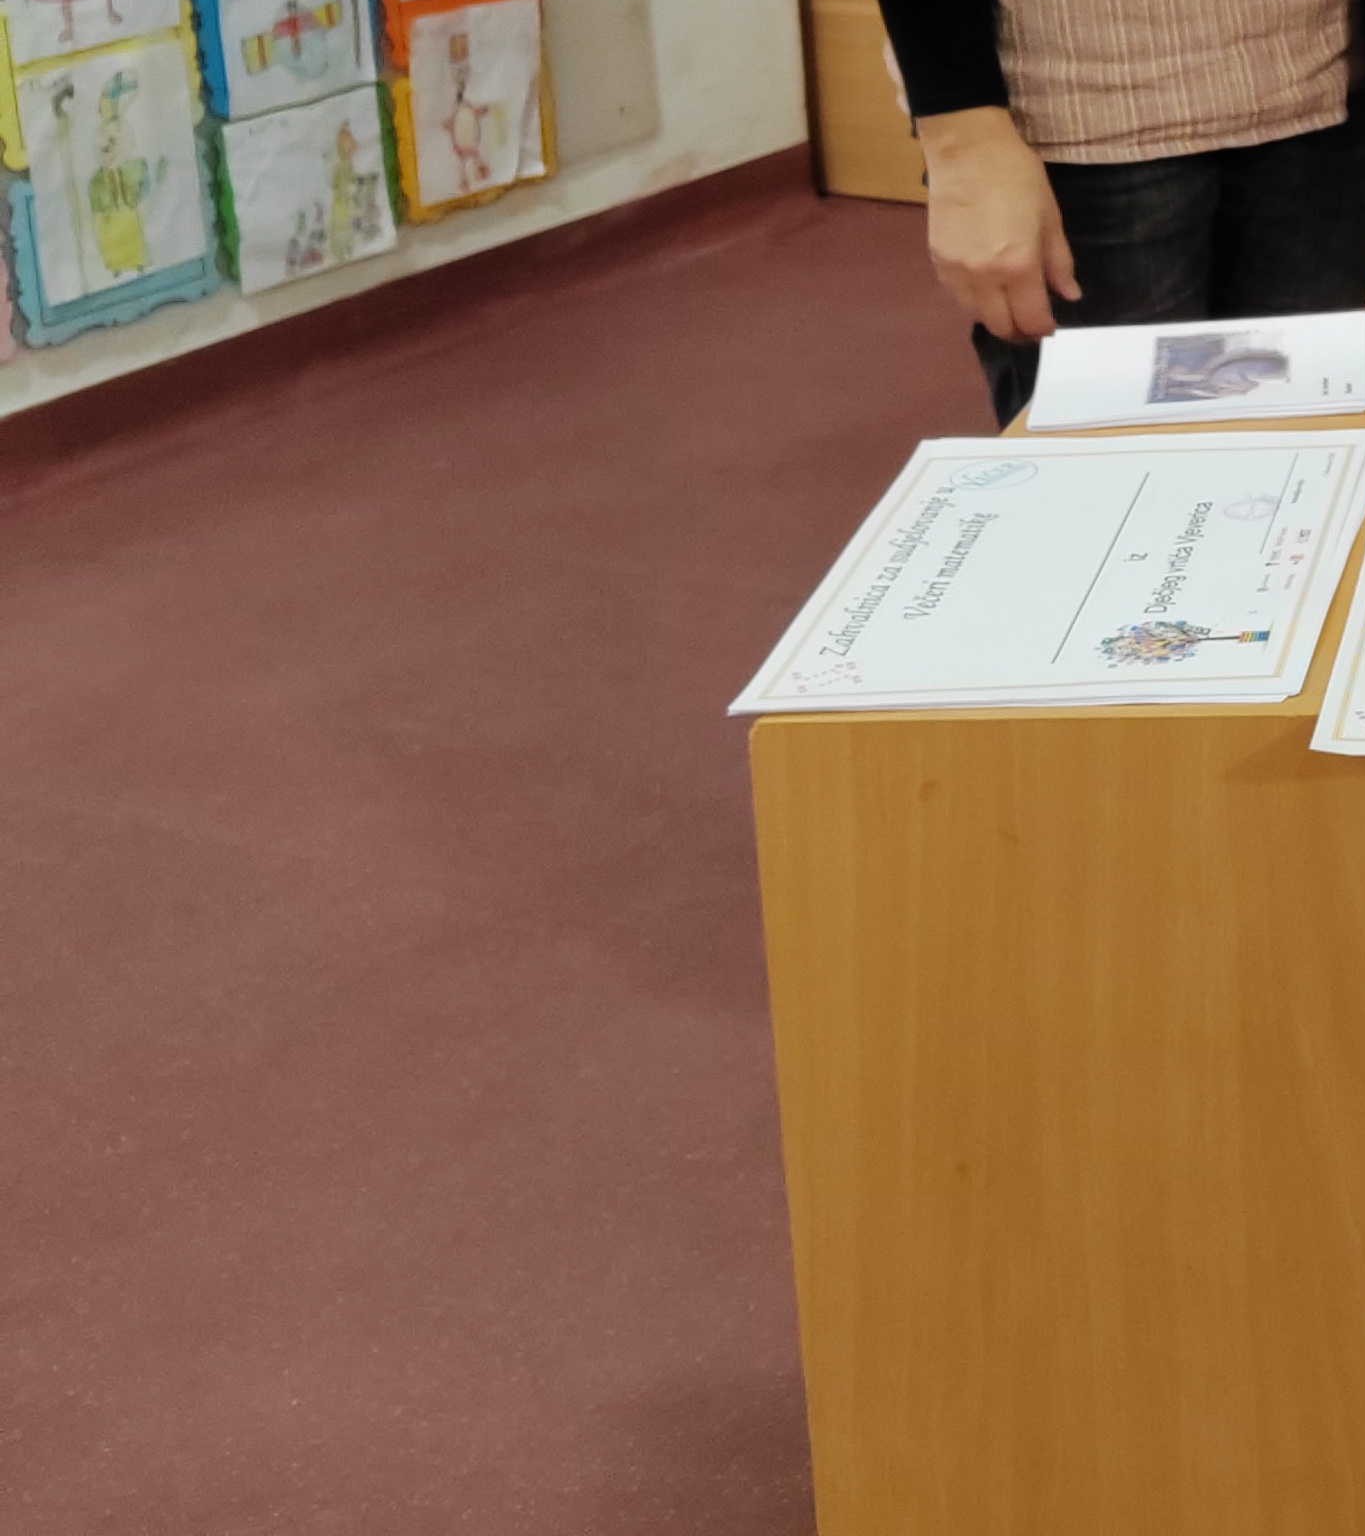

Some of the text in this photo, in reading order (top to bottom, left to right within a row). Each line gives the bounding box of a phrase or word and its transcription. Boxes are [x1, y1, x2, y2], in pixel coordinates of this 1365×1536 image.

[888, 495, 956, 565] sudjelovanje
[903, 511, 1000, 620] Večeri matematike
[1122, 551, 1149, 563] iz
[1144, 500, 1214, 614] Dječjeg vrtića Vjeverica
[877, 565, 903, 583] za
[818, 583, 890, 657] Zahvalnica
